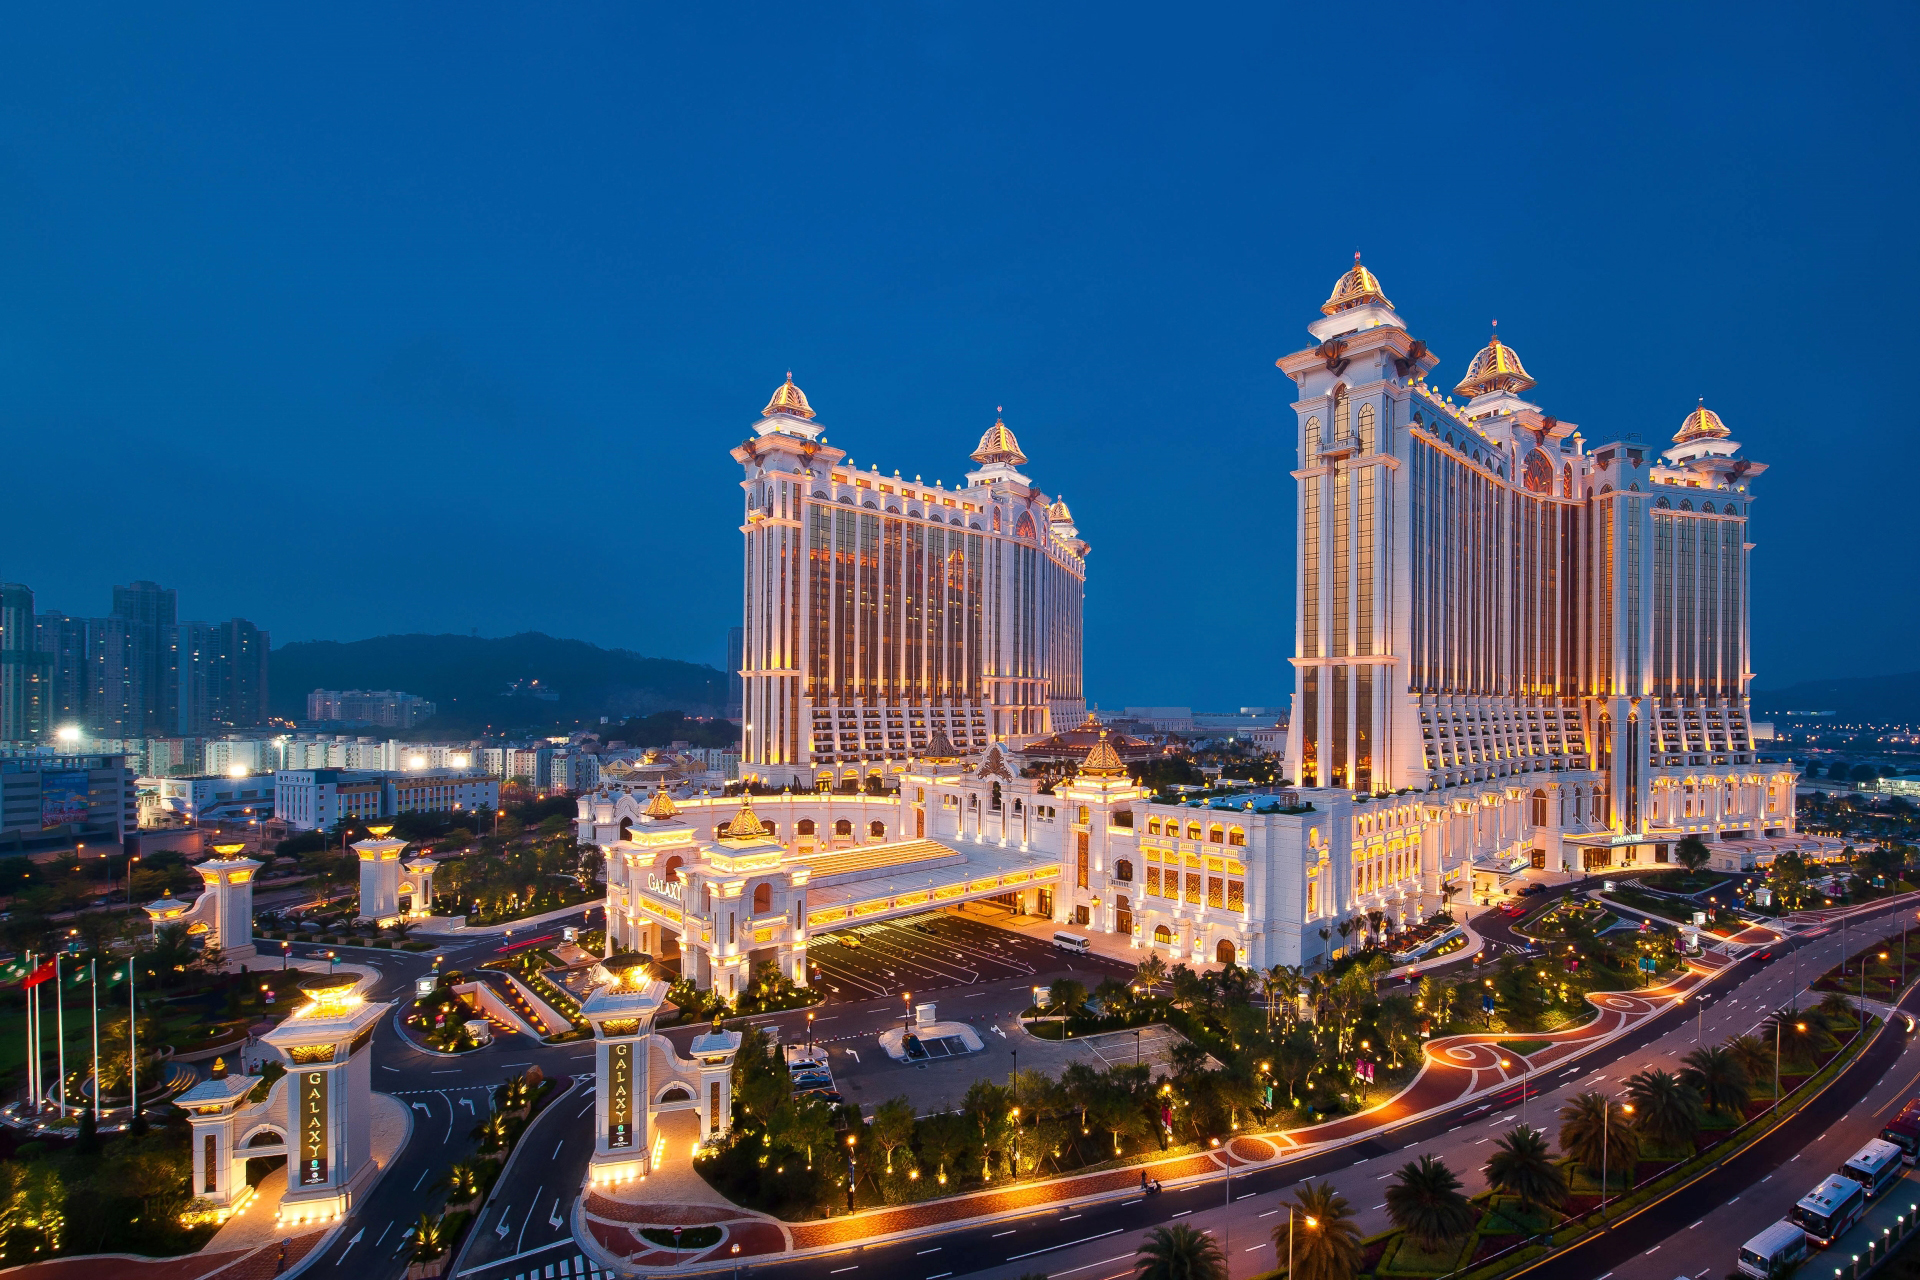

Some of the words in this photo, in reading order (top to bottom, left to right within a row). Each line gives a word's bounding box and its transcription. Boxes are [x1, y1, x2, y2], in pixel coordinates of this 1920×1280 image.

[648, 873, 682, 901] GALAXY
[308, 1073, 321, 1157] GALAXY
[616, 1045, 627, 1123] GALAXY
